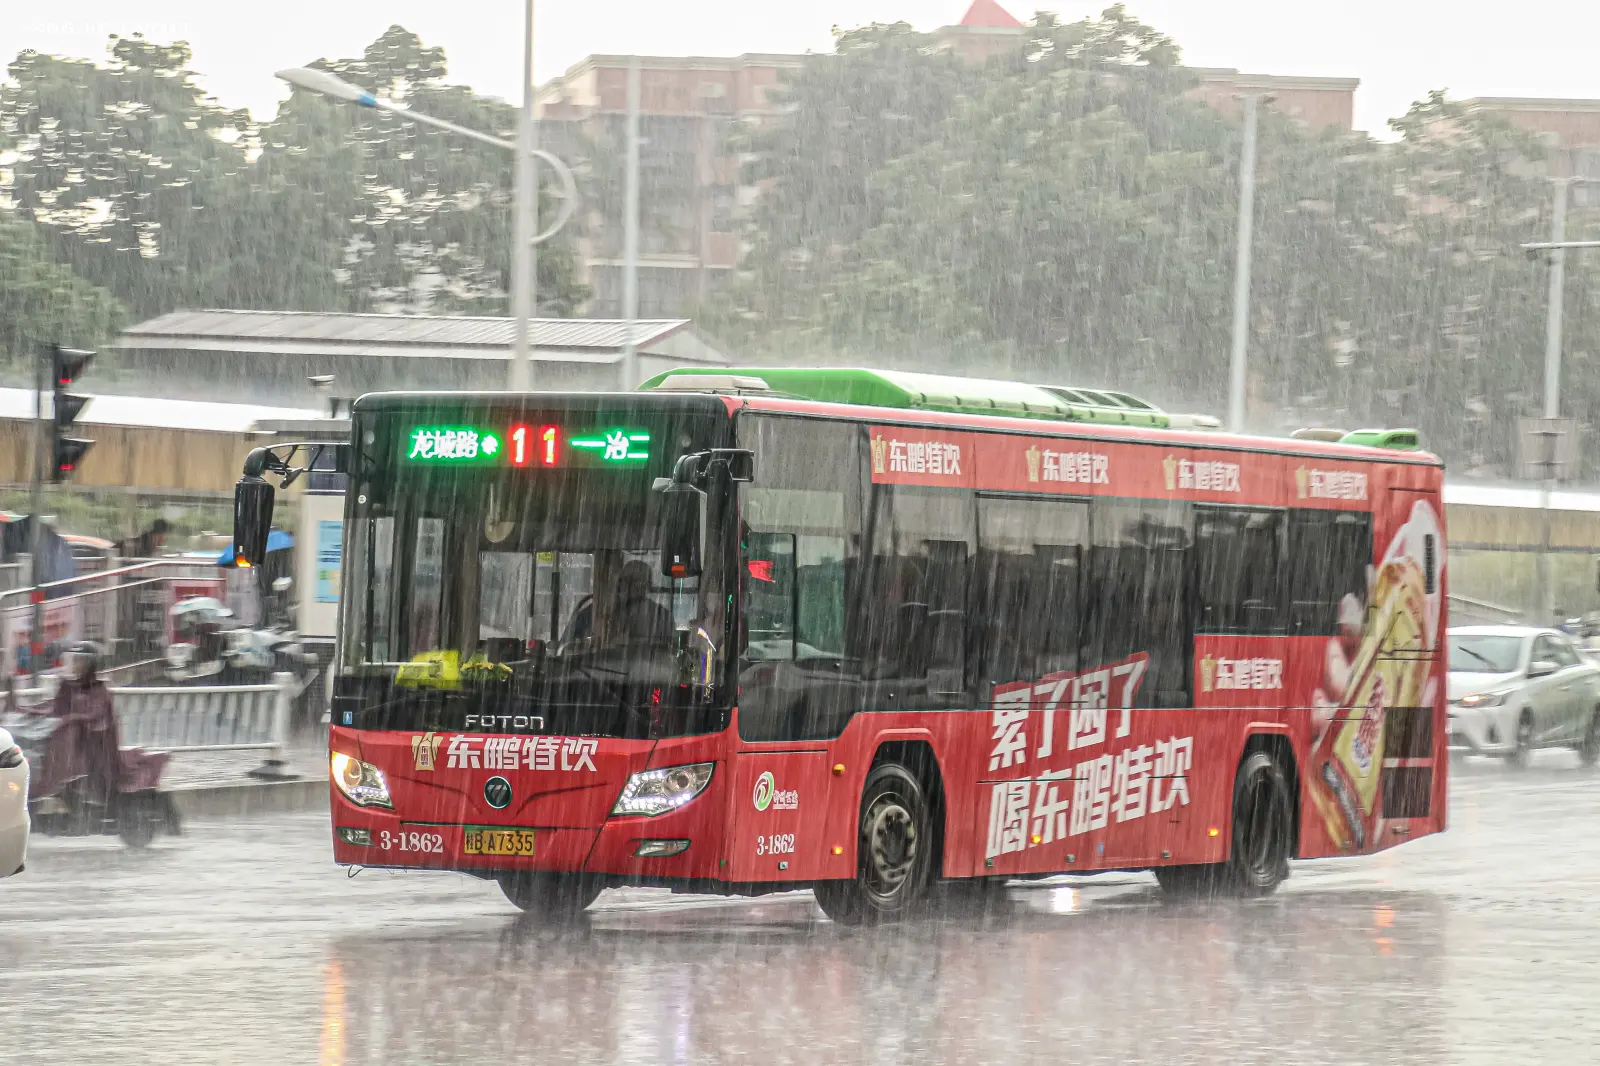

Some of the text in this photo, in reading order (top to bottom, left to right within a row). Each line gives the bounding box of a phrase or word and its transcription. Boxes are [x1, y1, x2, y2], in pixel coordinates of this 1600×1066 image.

[512, 427, 556, 463] 11
[889, 438, 962, 475] 东鹏特饮
[465, 714, 545, 730] FOTON
[988, 658, 1147, 772] 累了困了
[446, 734, 599, 772] 东鹏特饮
[986, 735, 1194, 859] 喝东鹏特饮
[380, 830, 444, 854] 3-1862
[756, 833, 795, 856] 3-1862
